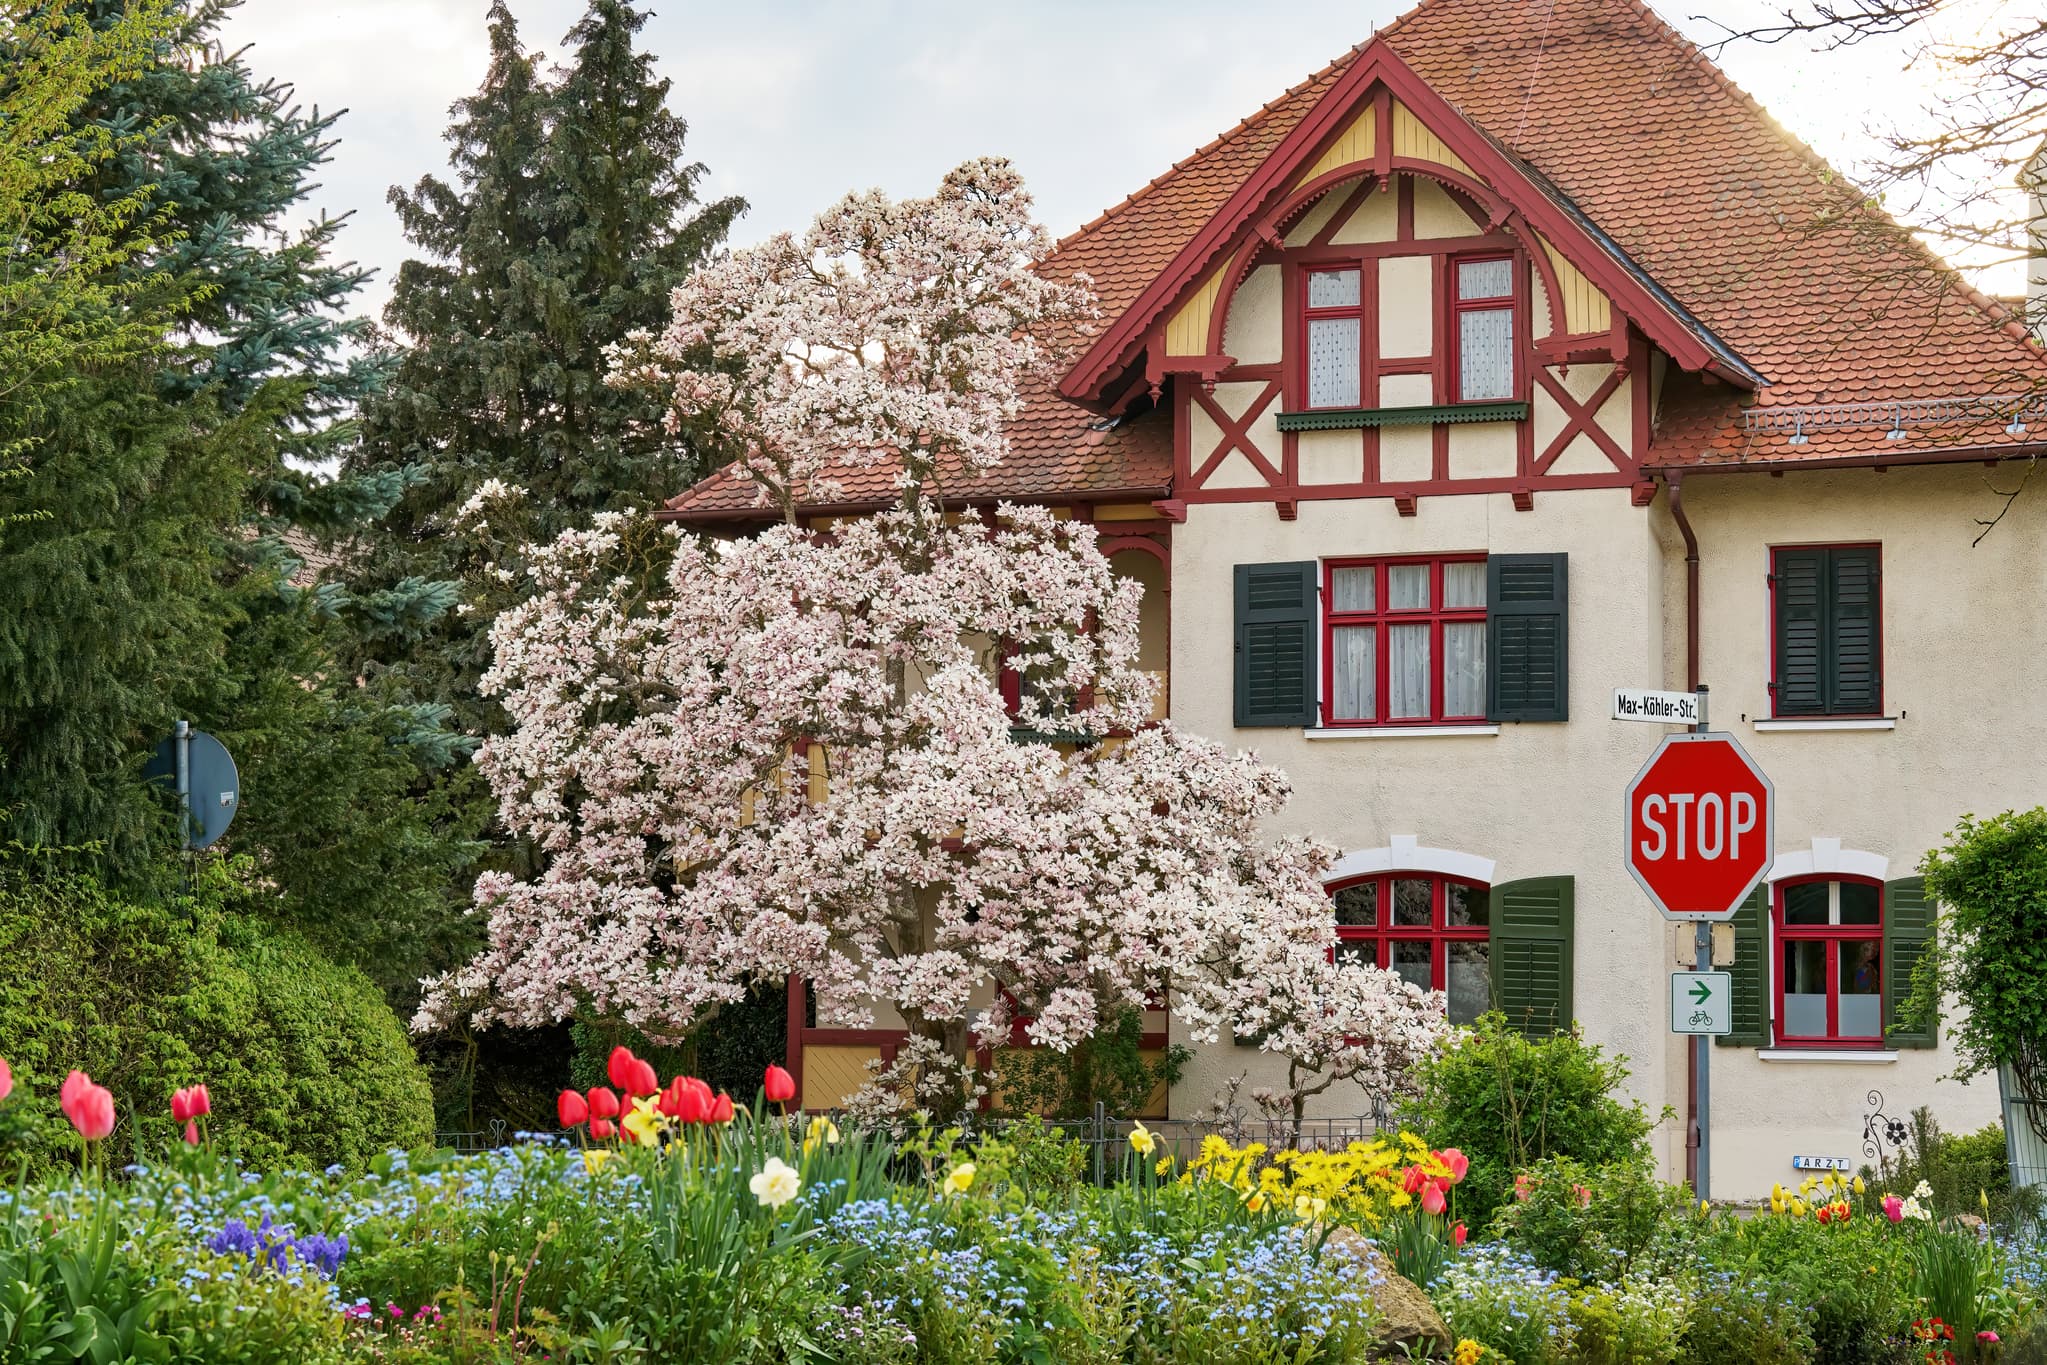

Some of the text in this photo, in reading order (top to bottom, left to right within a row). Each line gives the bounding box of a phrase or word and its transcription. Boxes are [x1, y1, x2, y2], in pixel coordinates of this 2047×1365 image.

[1618, 694, 1697, 719] Max-Köhler-Str.
[1641, 792, 1756, 860] STOP
[1804, 1158, 1843, 1168] ARZT
